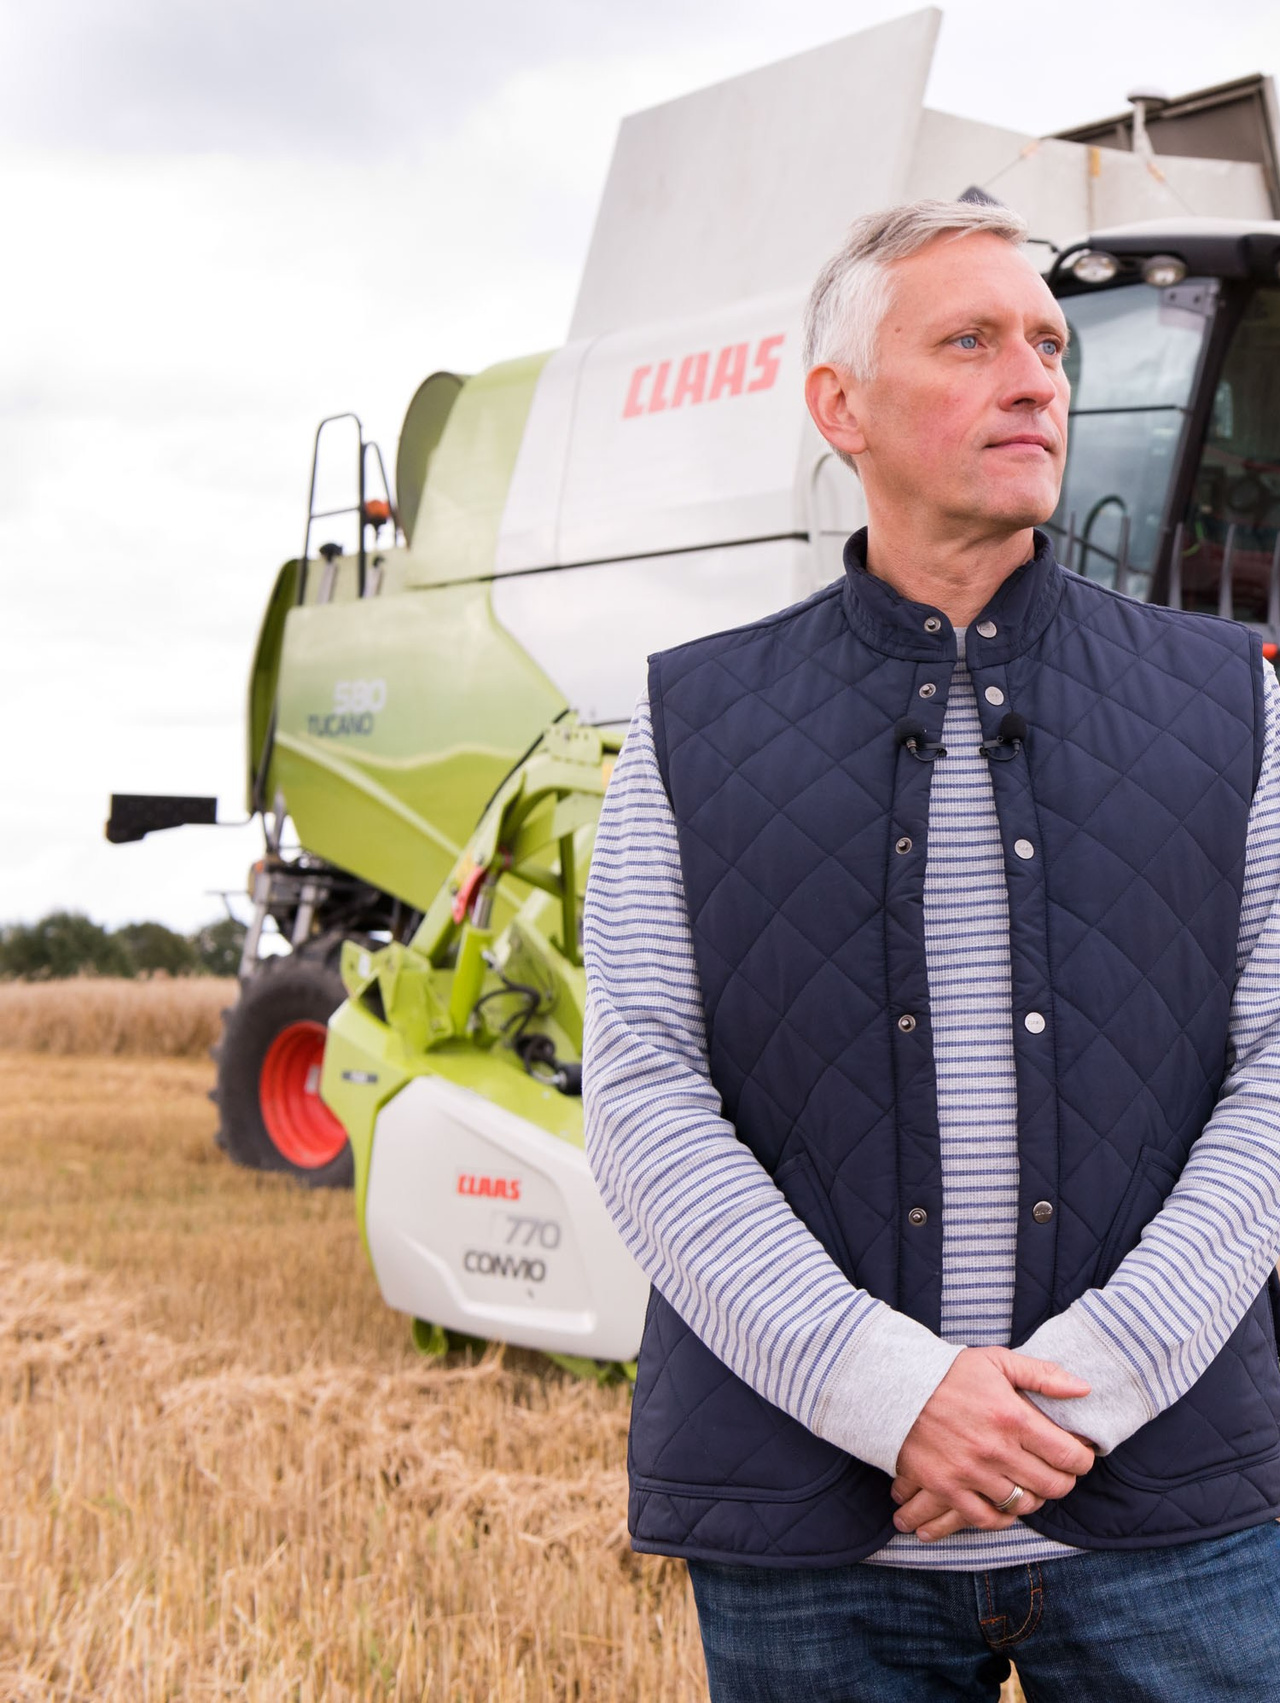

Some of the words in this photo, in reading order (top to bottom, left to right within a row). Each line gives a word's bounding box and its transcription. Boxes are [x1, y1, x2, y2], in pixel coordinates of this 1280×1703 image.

[622, 333, 785, 419] CLAAS
[333, 679, 386, 713] 580
[307, 712, 373, 738] TUCANO
[458, 1174, 520, 1201] CLAAS
[506, 1215, 561, 1249] 770
[464, 1251, 546, 1282] CONVIO
